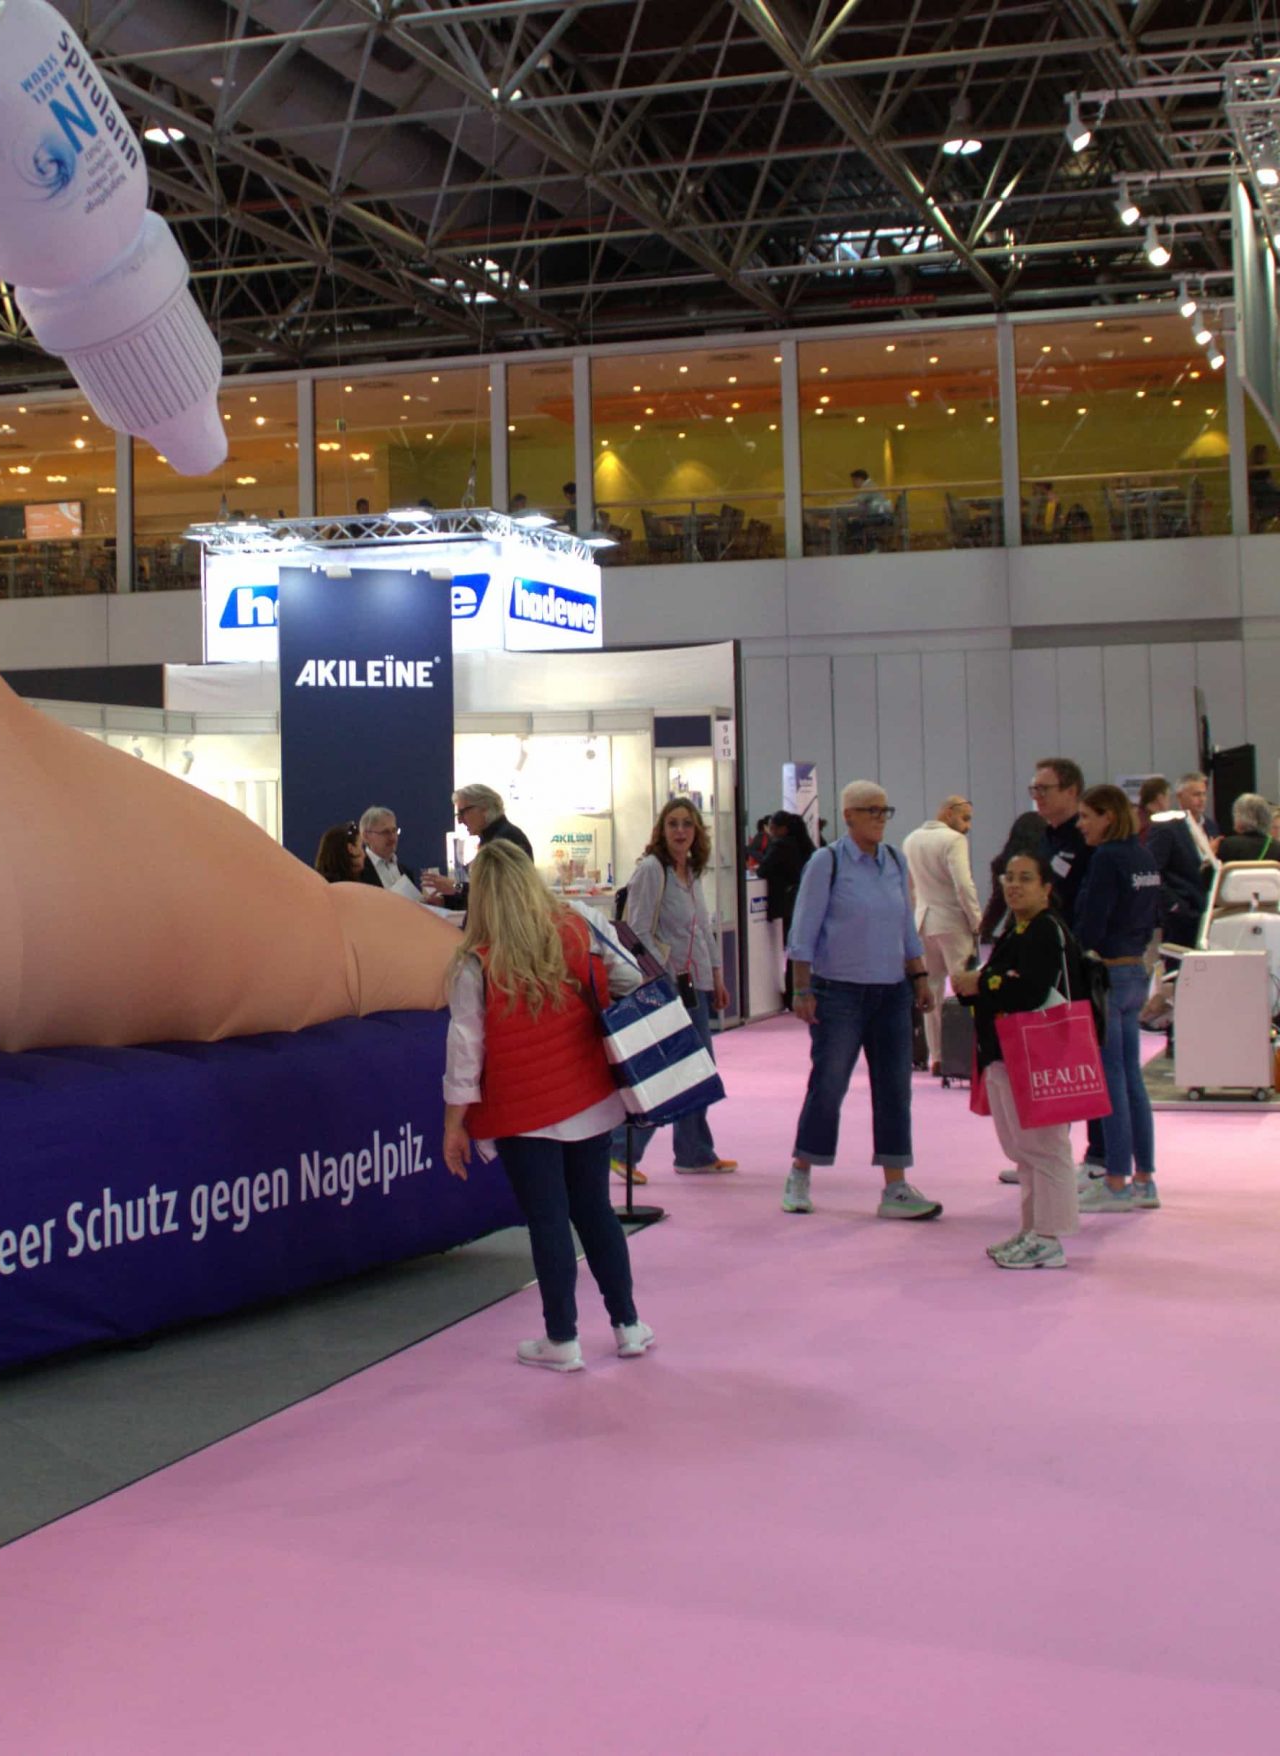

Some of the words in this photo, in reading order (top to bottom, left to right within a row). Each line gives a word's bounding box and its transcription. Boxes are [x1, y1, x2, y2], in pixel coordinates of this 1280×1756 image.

[21, 53, 58, 93] SERUM
[514, 577, 596, 632] hadewe
[1032, 1063, 1097, 1089] BEAUTY
[66, 1184, 179, 1257] Schutz
[190, 1167, 290, 1242] gegen
[299, 1121, 434, 1206] Nagelpilz.
